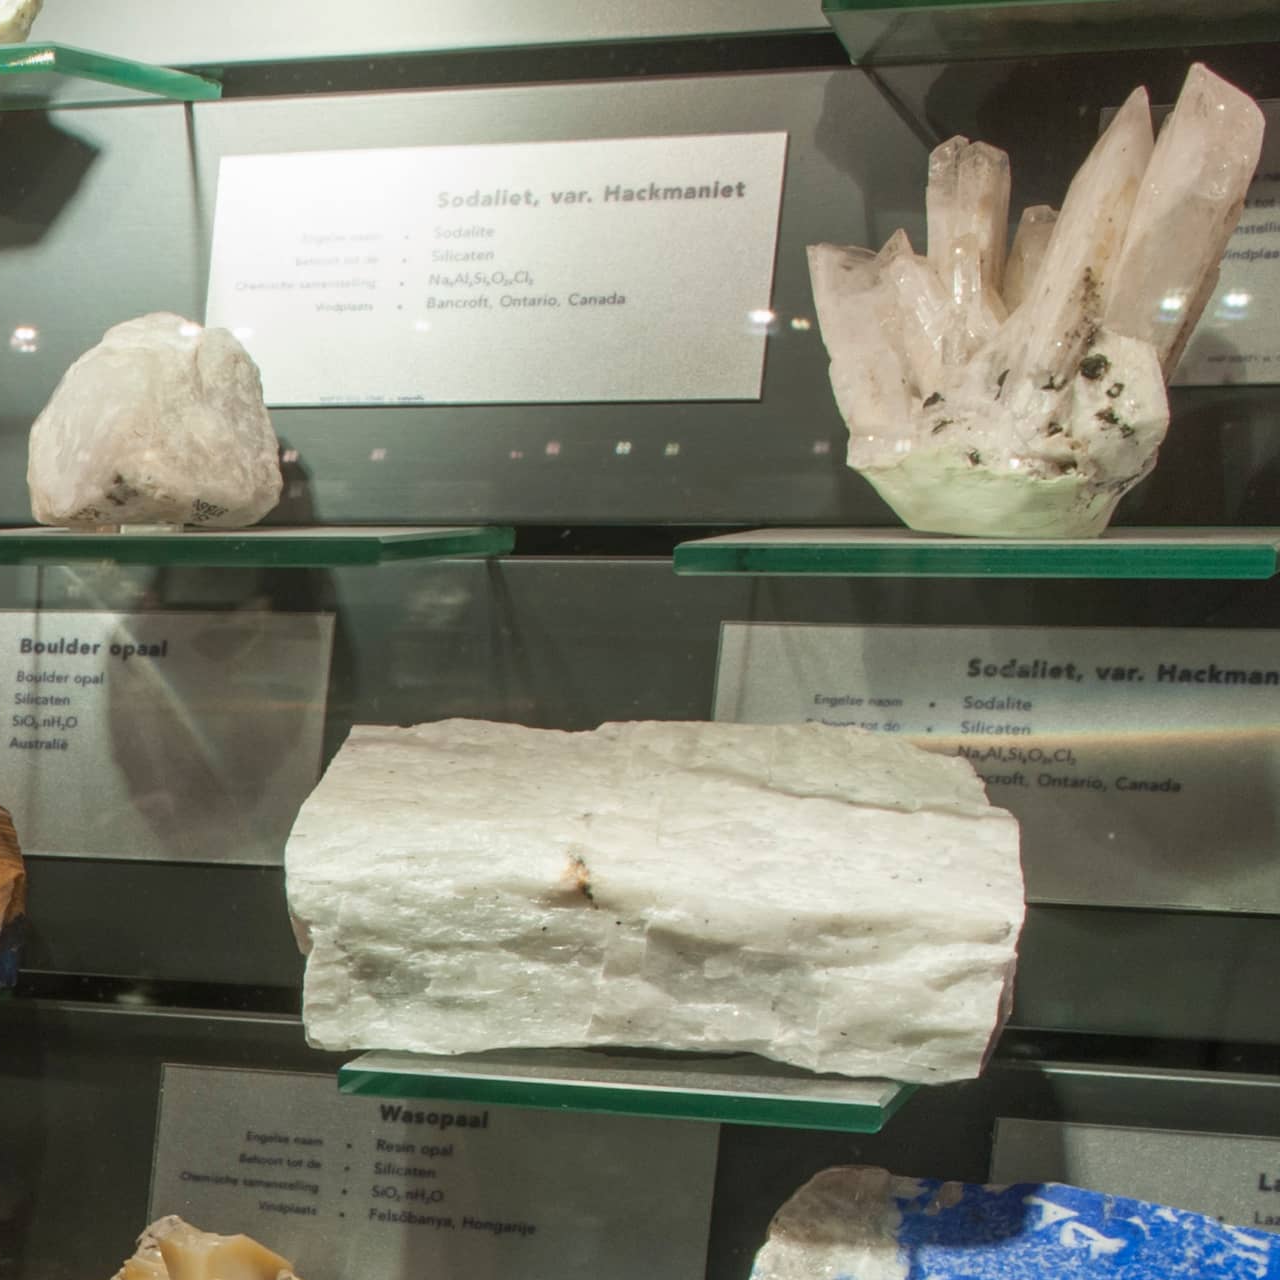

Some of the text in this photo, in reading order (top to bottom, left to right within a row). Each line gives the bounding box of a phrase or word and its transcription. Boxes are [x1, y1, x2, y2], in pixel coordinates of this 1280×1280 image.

[437, 180, 747, 211] Sodaliet, var. Hackmaniet
[434, 224, 495, 241] Sodalite
[431, 248, 495, 263] Silicaten
[426, 291, 626, 311] Bancroft, Ontario, Canada
[19, 638, 169, 661] Boulder opaal
[967, 657, 1084, 681] Sodaliet,
[1096, 666, 1143, 682] var.
[16, 671, 105, 688] Boulder opal
[14, 693, 71, 707] Silicaten
[963, 696, 1032, 711] Sodalite
[960, 721, 1031, 736] Silicaten
[1037, 774, 1107, 791] Ontario,
[1115, 778, 1181, 793] Canada
[380, 1103, 490, 1130] Wasopaal
[376, 1139, 454, 1158] Resin opal
[374, 1162, 437, 1180] Silicaten
[462, 1215, 537, 1237] Hongarije
